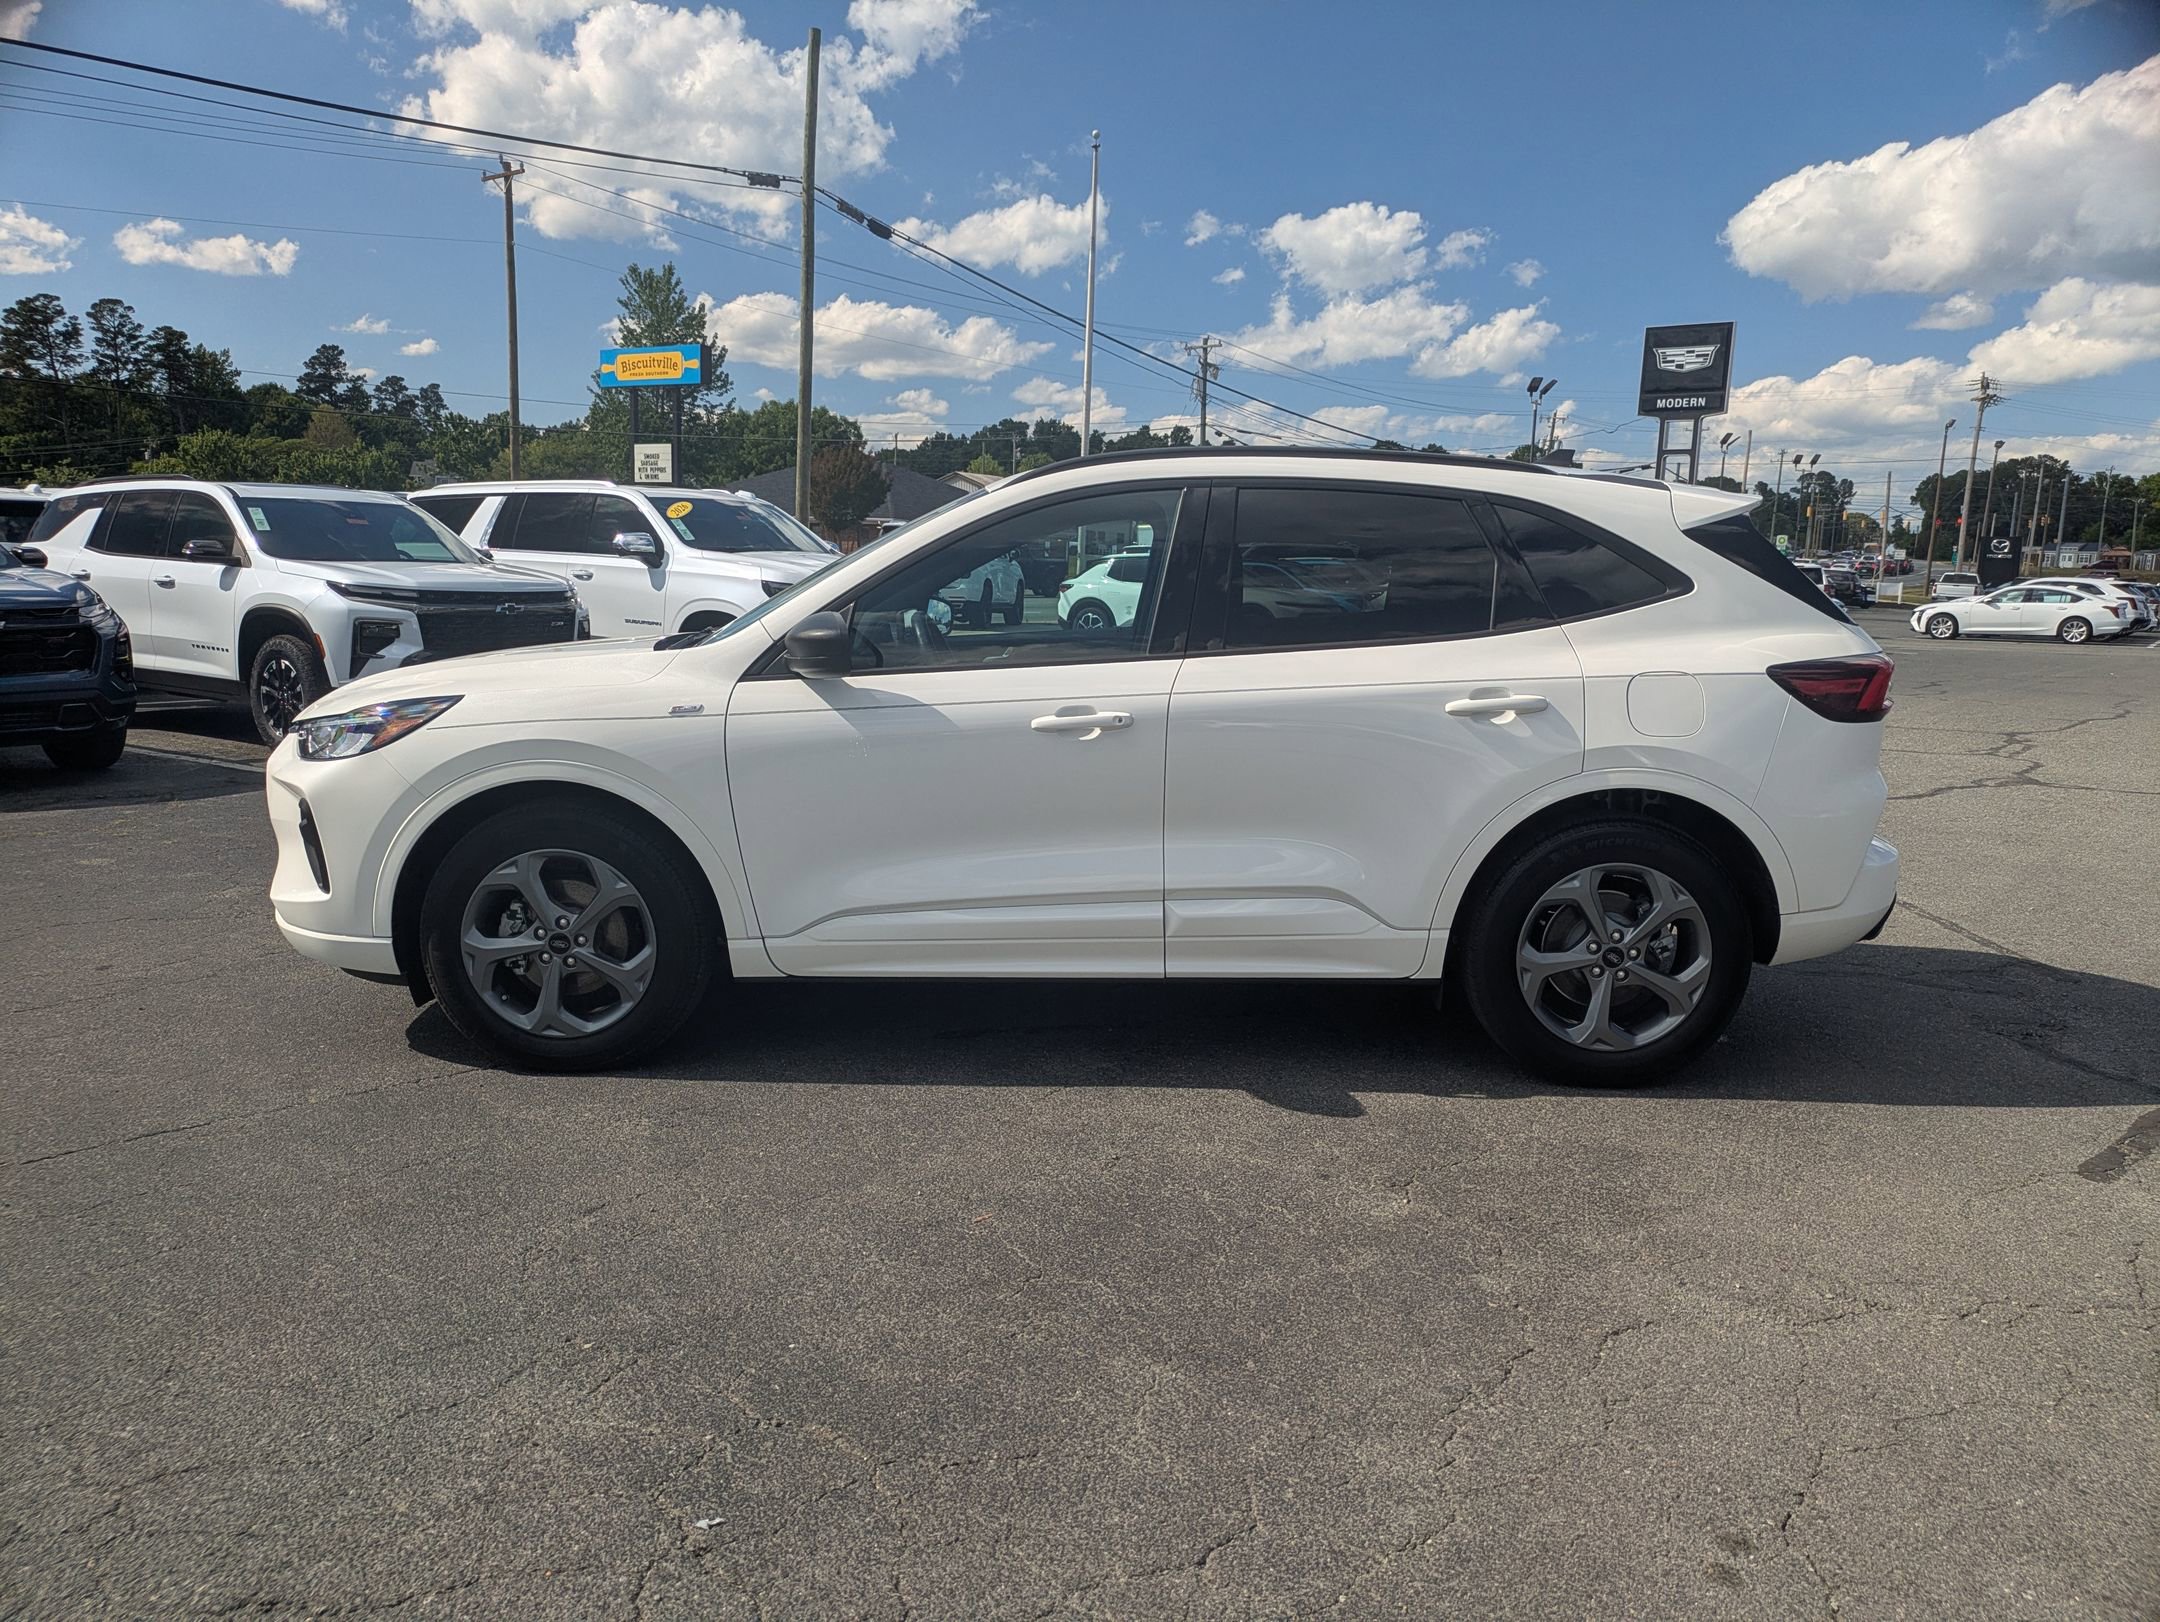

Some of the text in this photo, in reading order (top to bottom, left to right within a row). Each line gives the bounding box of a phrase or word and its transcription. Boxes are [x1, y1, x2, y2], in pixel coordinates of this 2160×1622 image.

[621, 356, 678, 373] Biscuitville
[1656, 397, 1706, 408] MODERN
[669, 503, 689, 516] 2026
